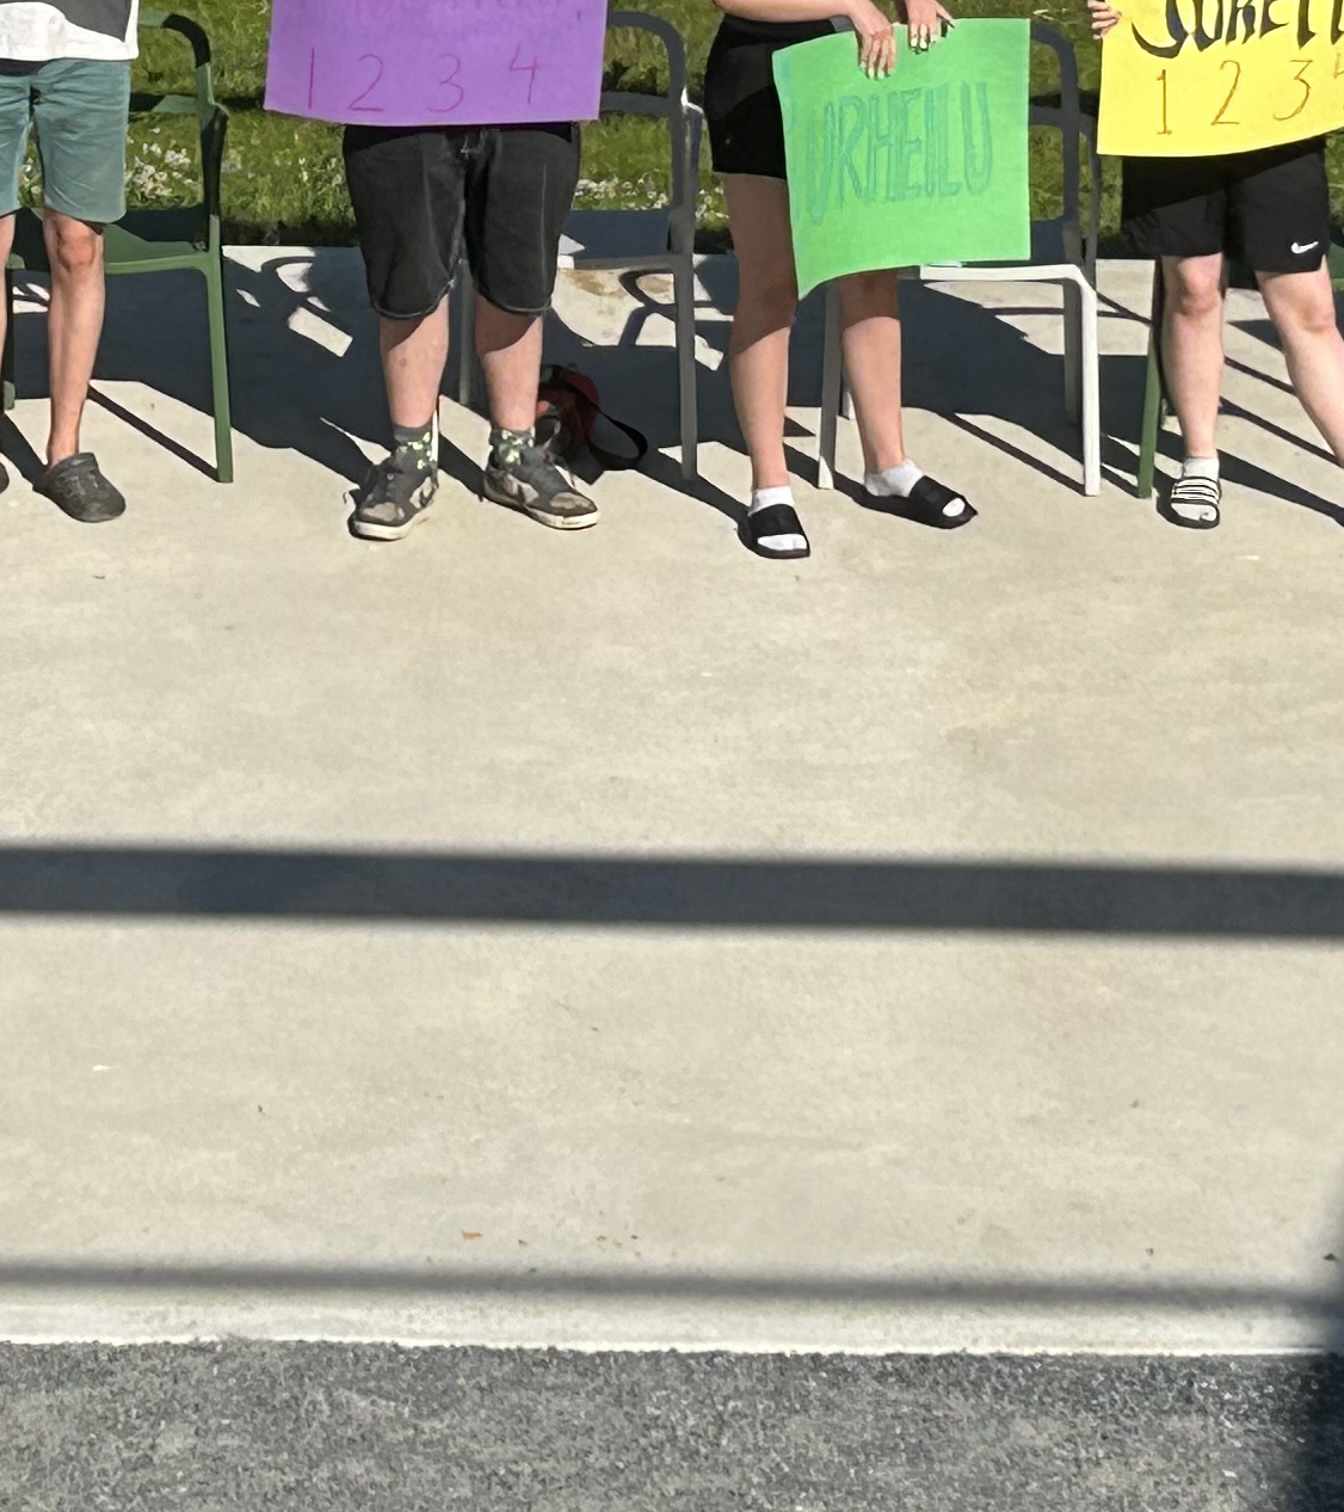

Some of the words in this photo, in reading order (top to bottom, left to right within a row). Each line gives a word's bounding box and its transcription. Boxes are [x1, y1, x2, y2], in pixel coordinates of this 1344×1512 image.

[307, 47, 316, 110] 1
[346, 53, 385, 113] 2
[426, 53, 465, 114] 3
[508, 41, 542, 105] 4
[1156, 69, 1173, 136] 1
[1210, 59, 1242, 126] 2
[1272, 59, 1313, 122] 3
[805, 80, 995, 225] URHEILU
